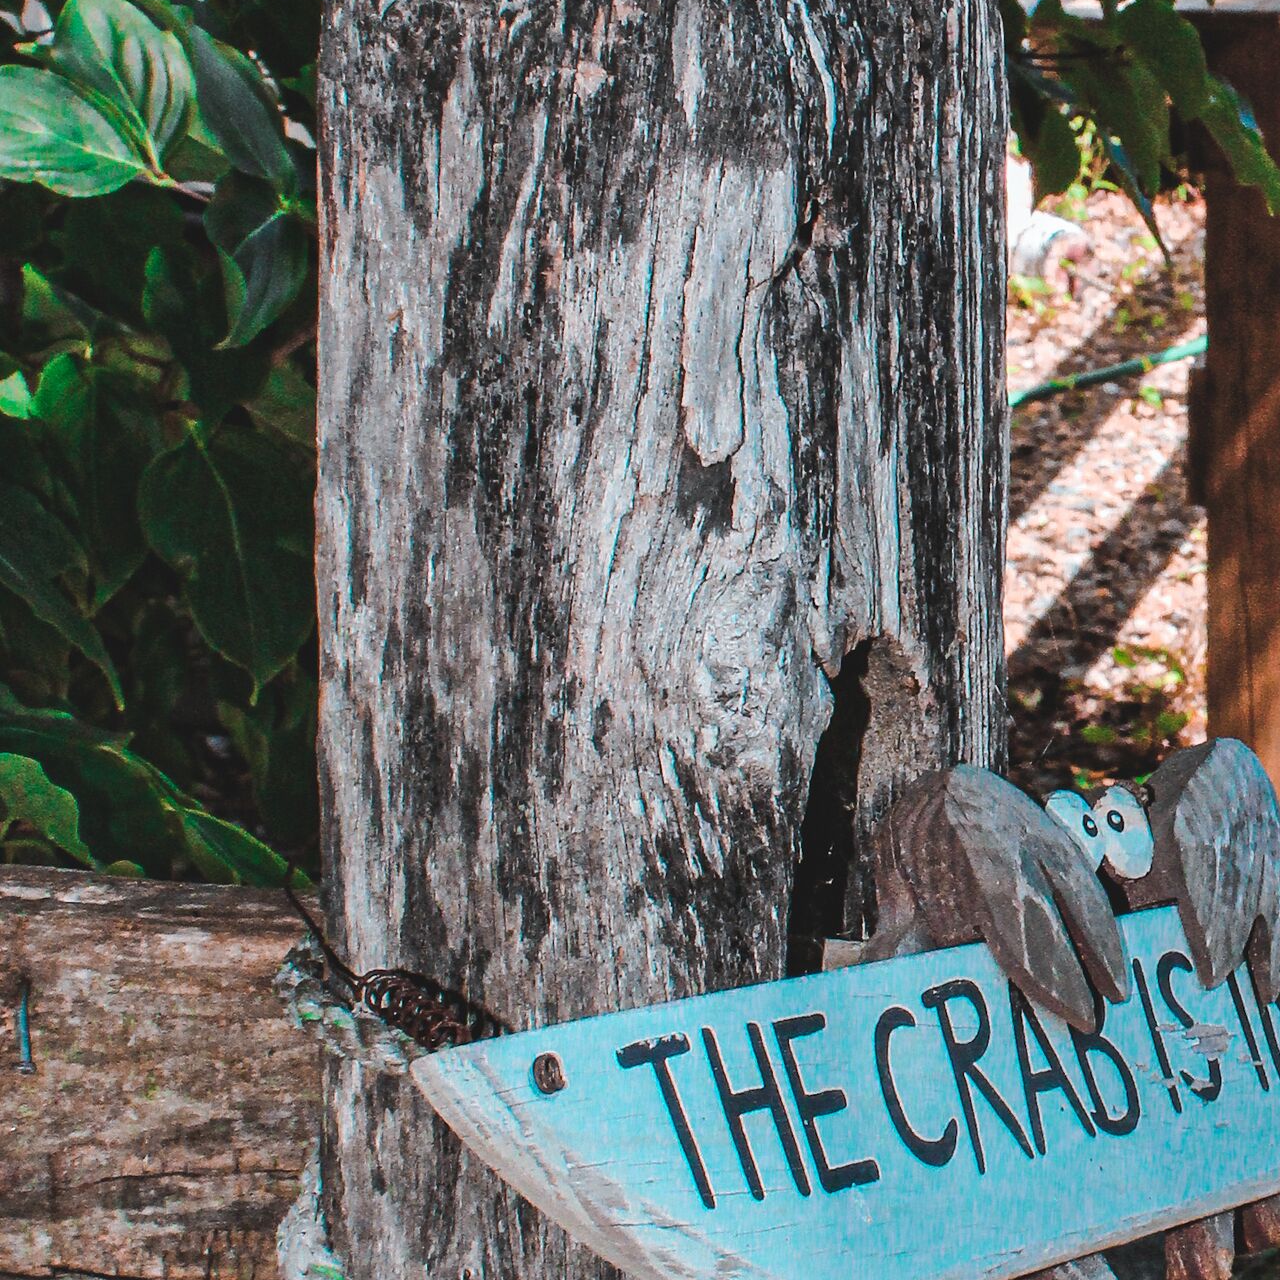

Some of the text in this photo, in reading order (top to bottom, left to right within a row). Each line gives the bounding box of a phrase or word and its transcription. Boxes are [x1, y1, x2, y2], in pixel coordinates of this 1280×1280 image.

[616, 1013, 880, 1209] THE
[874, 978, 1140, 1176] CRAB
[1132, 950, 1222, 1114] IS
